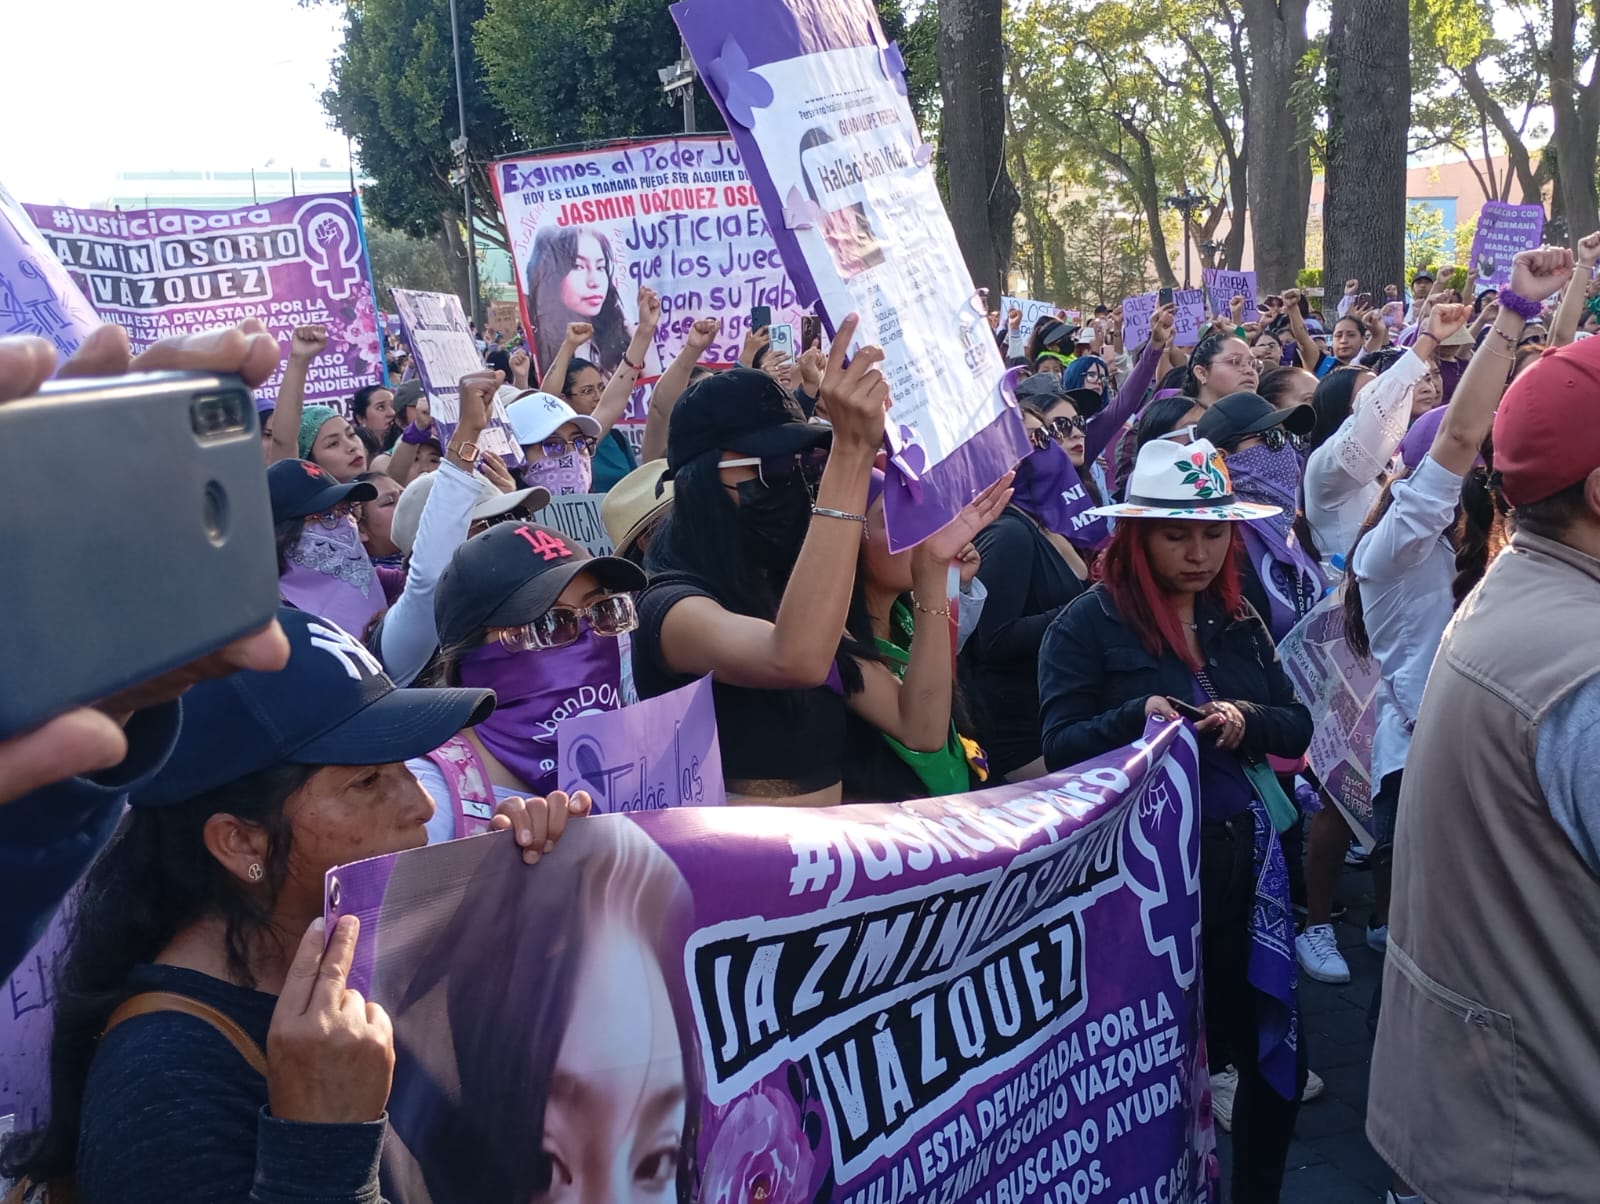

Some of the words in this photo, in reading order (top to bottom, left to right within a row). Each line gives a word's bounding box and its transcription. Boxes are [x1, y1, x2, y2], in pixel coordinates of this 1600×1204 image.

[611, 149, 635, 175] al
[640, 139, 705, 172] Poder
[522, 190, 545, 206] HOY
[549, 188, 562, 201] ES
[565, 184, 590, 199] ELLA
[639, 172, 670, 190] PUEDE
[671, 171, 690, 185] SER
[692, 169, 736, 184] ALGUIEN
[52, 207, 272, 238] #justiciapara
[556, 194, 637, 227] JASMIN
[1482, 218, 1494, 227] MI
[1494, 220, 1537, 230] HERMANA
[1520, 210, 1539, 218] CON
[54, 237, 151, 274] AZMÍN
[165, 230, 297, 268] OSORIO
[1487, 232, 1510, 242] PARA
[1512, 234, 1527, 243] NO
[93, 268, 262, 307] VÁZQUEZ
[629, 256, 663, 288] que
[672, 252, 712, 278] los
[134, 311, 169, 329] ESTA
[173, 304, 267, 325] DEVASTADA
[270, 300, 304, 316] POR
[306, 298, 328, 311] LA
[709, 284, 743, 312] su
[308, 353, 345, 369] ASO
[1061, 482, 1087, 505] NI
[513, 524, 574, 562] LA
[306, 616, 384, 681] NY
[711, 898, 974, 1063] JAZMÍN
[823, 925, 1078, 1142] VÁZQUEZ
[917, 1113, 977, 1186] ESTA
[976, 1032, 1085, 1142] DEVASTADA
[1085, 1006, 1139, 1057] POR
[1139, 991, 1175, 1032] LA
[995, 1083, 1069, 1165] OSORIO
[1070, 1025, 1187, 1107] VAZQUEZ.
[996, 1118, 1100, 1204] BUSCADO
[1106, 1074, 1183, 1145] AYUDA
[1154, 1149, 1191, 1204] CASO
